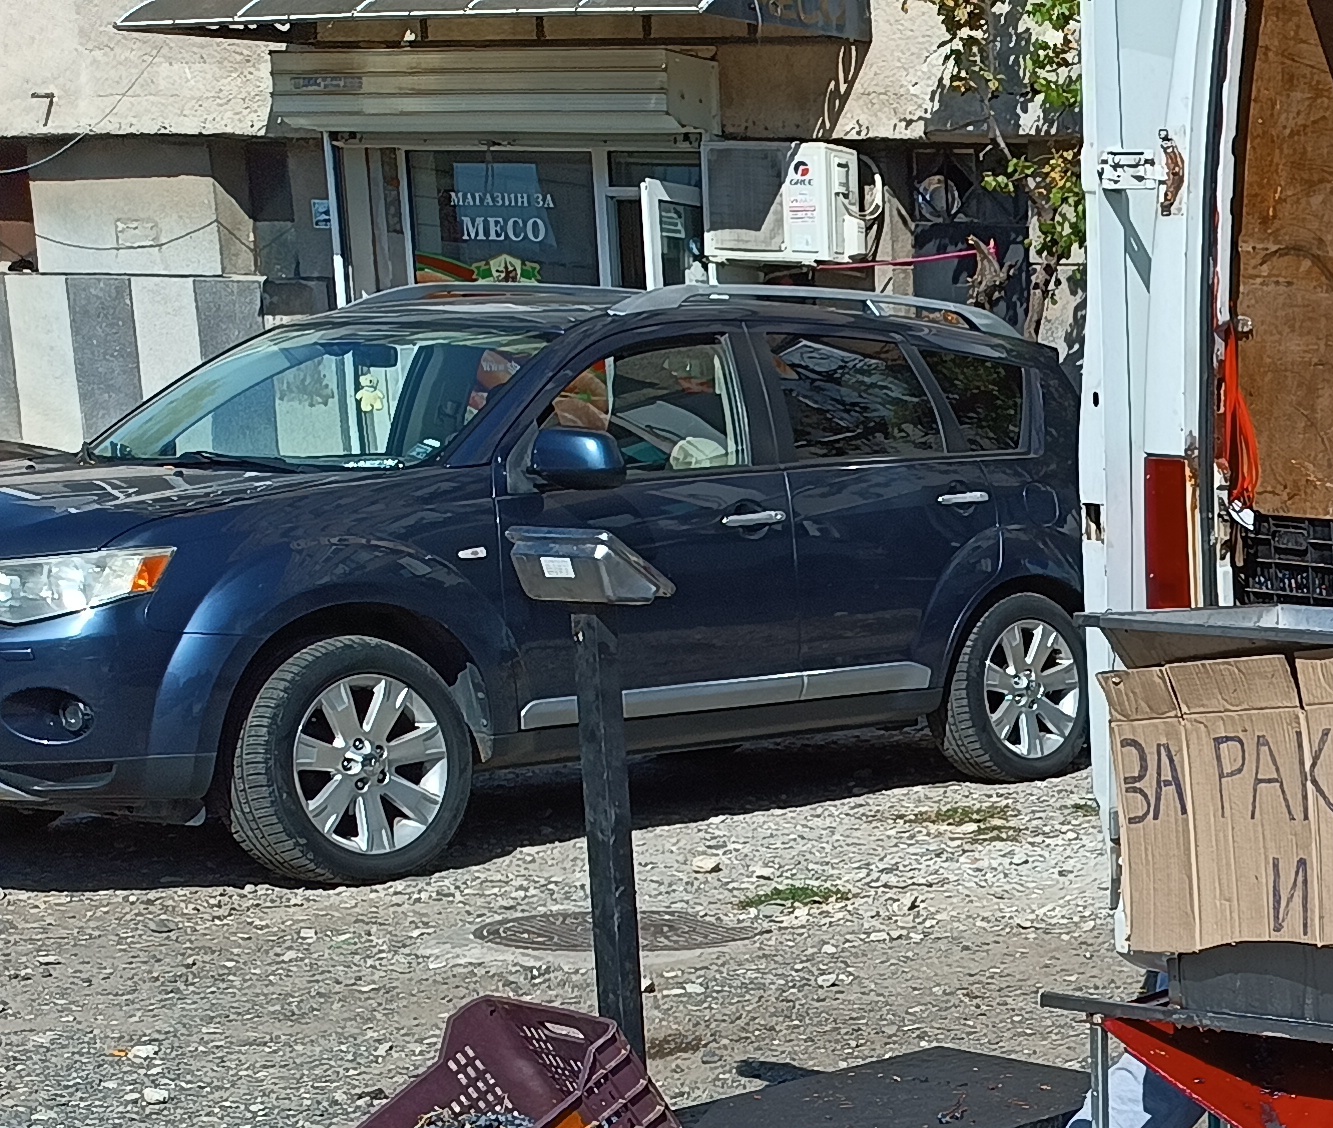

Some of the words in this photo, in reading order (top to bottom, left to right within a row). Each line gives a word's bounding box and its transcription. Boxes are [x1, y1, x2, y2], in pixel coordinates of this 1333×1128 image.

[450, 191, 529, 208] МАГАЗИН
[533, 193, 555, 208] ЗА
[461, 217, 546, 242] МЕСО
[1119, 737, 1188, 825] ЗА
[1272, 856, 1309, 937] И
